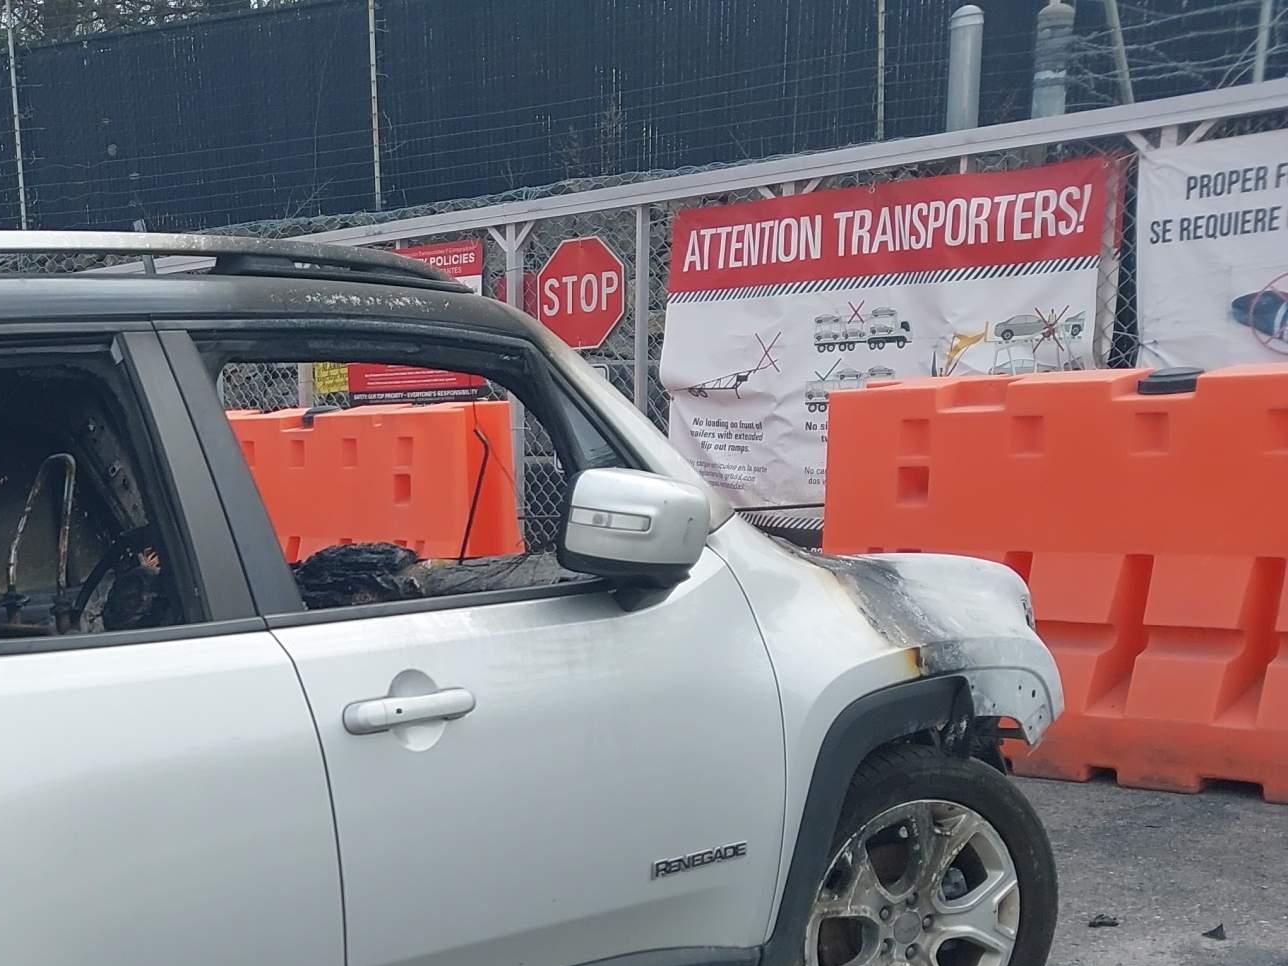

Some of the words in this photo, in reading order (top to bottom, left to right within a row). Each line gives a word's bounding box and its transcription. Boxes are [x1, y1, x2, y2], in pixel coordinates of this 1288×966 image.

[1185, 165, 1269, 200] PROPER
[682, 214, 823, 273] ATTENTION
[832, 183, 1093, 257] TRANSPORTERS!
[1149, 218, 1173, 245] SE
[1179, 206, 1282, 241] REQUIERE
[430, 253, 476, 267] POLICIES
[542, 270, 619, 317] STOP
[692, 417, 704, 426] No
[705, 418, 729, 429] loading
[739, 420, 755, 429] front
[756, 421, 763, 430] of
[717, 430, 733, 440] with
[734, 432, 764, 441] extended
[805, 422, 818, 431] No
[700, 440, 713, 451] flip
[714, 443, 727, 451] out
[728, 444, 751, 454] ramps.
[652, 840, 748, 879] RENEGADE
